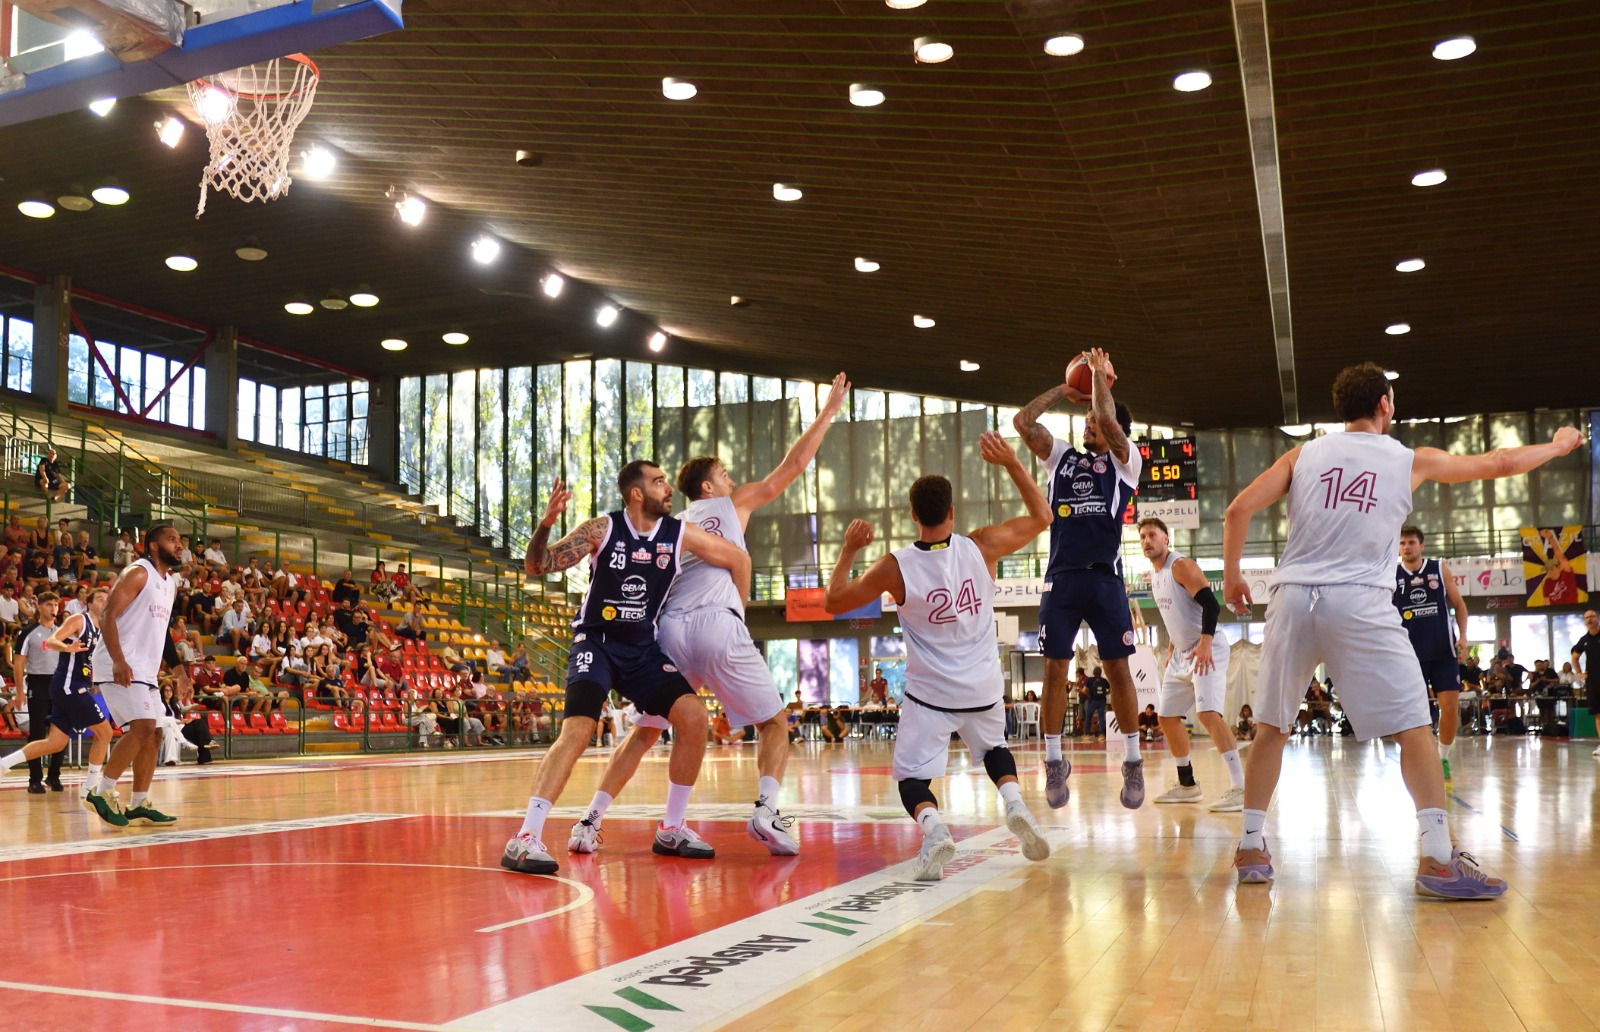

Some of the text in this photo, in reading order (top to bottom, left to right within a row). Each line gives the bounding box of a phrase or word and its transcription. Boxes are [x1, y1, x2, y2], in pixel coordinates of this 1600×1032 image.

[1140, 446, 1150, 459] 4
[1182, 443, 1193, 457] 4
[1060, 463, 1076, 478] 44
[1320, 467, 1378, 514] 14
[1143, 507, 1197, 517] CAPPELLI
[609, 552, 626, 570] 29
[621, 583, 647, 592] GEMA
[1399, 584, 1405, 595] 7
[926, 579, 982, 624] 24
[576, 651, 593, 666] 29
[639, 934, 812, 988] Alisped
